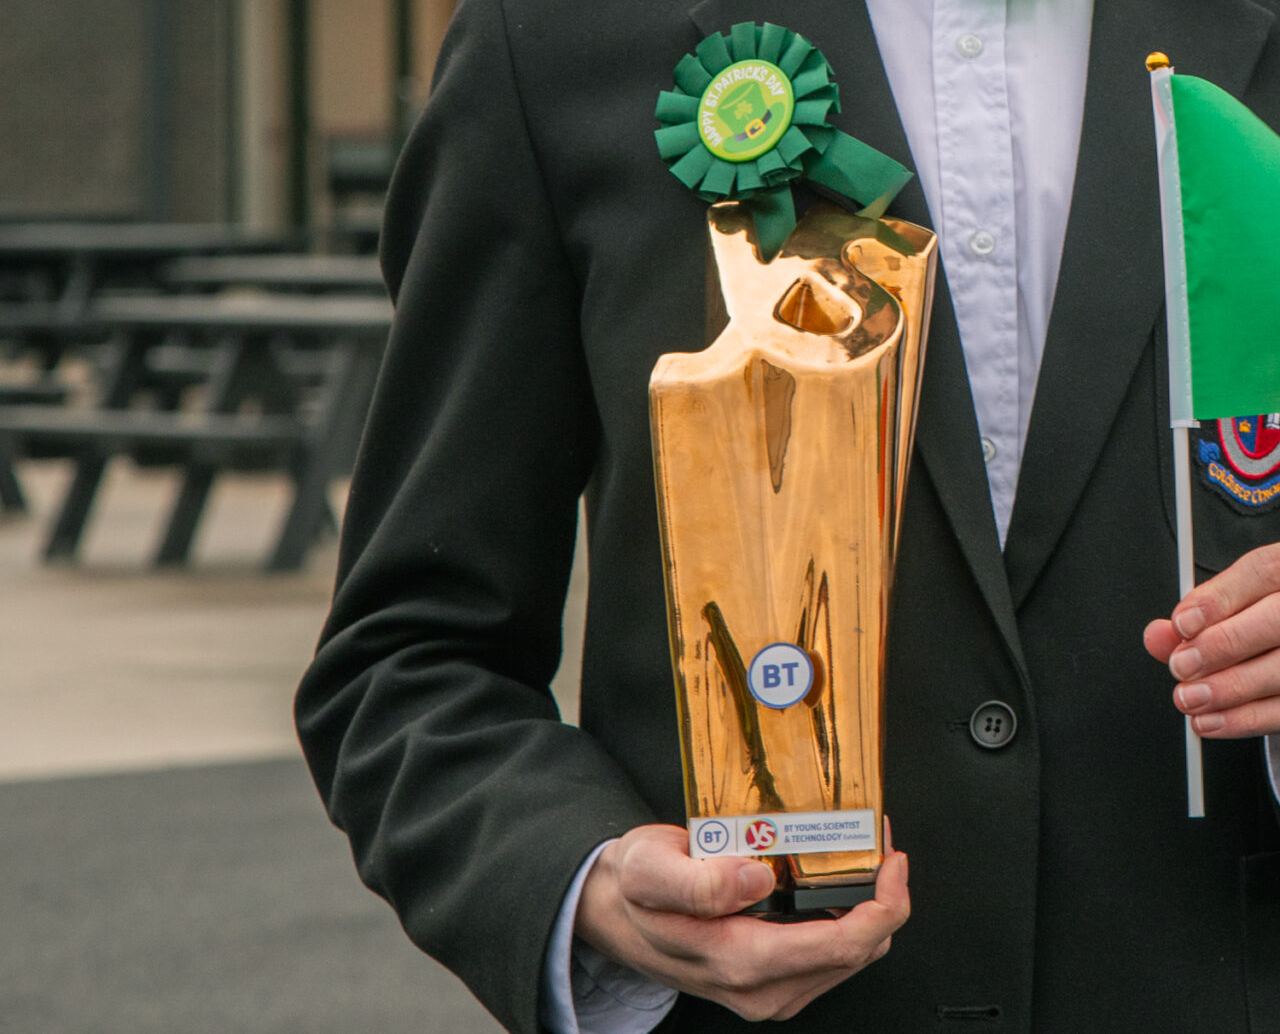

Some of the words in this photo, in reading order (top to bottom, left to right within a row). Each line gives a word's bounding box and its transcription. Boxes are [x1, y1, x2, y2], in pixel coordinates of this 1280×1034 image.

[702, 110, 722, 147] HAPPY
[765, 74, 785, 96] DAY
[762, 662, 799, 689] BT
[784, 824, 793, 833] BT
[795, 822, 822, 831] YOUNG
[823, 821, 860, 830] SCIENTIST
[704, 831, 722, 843] BT
[792, 833, 842, 843] TECHNOLOGY
